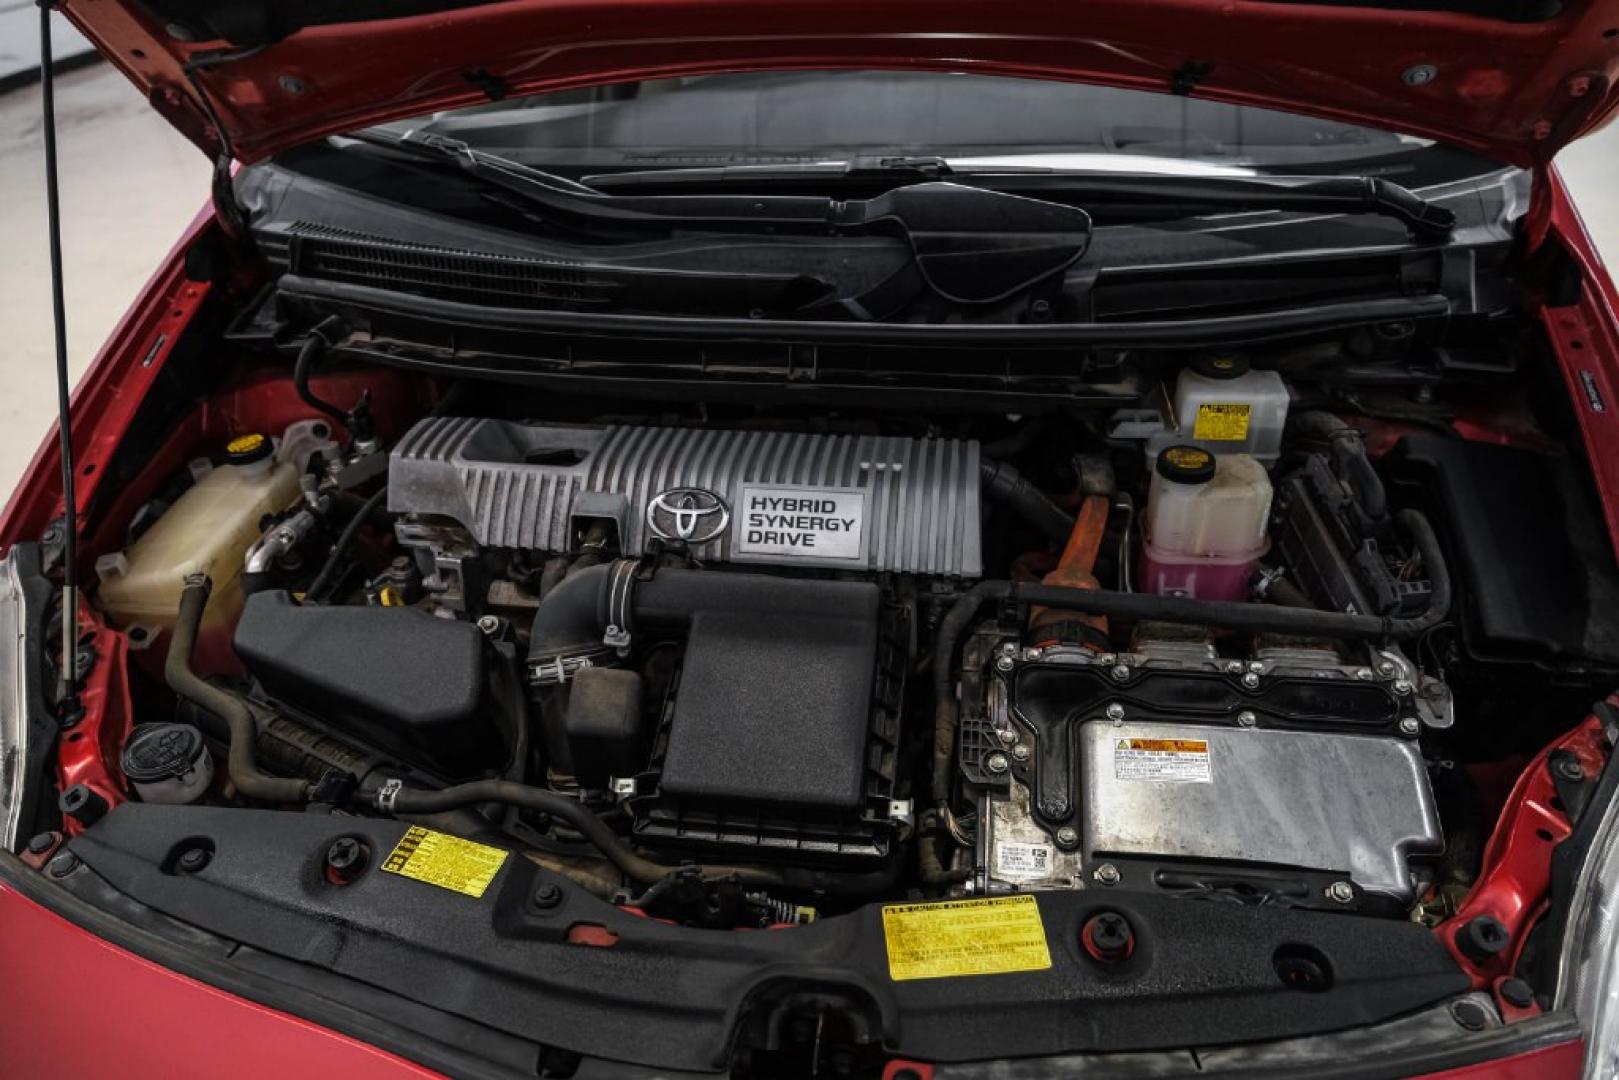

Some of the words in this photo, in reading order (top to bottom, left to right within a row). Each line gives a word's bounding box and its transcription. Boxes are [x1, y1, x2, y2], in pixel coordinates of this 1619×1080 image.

[750, 496, 836, 514] HYBRID
[748, 513, 856, 532] SYNERGY
[747, 530, 816, 547] DRIVE
